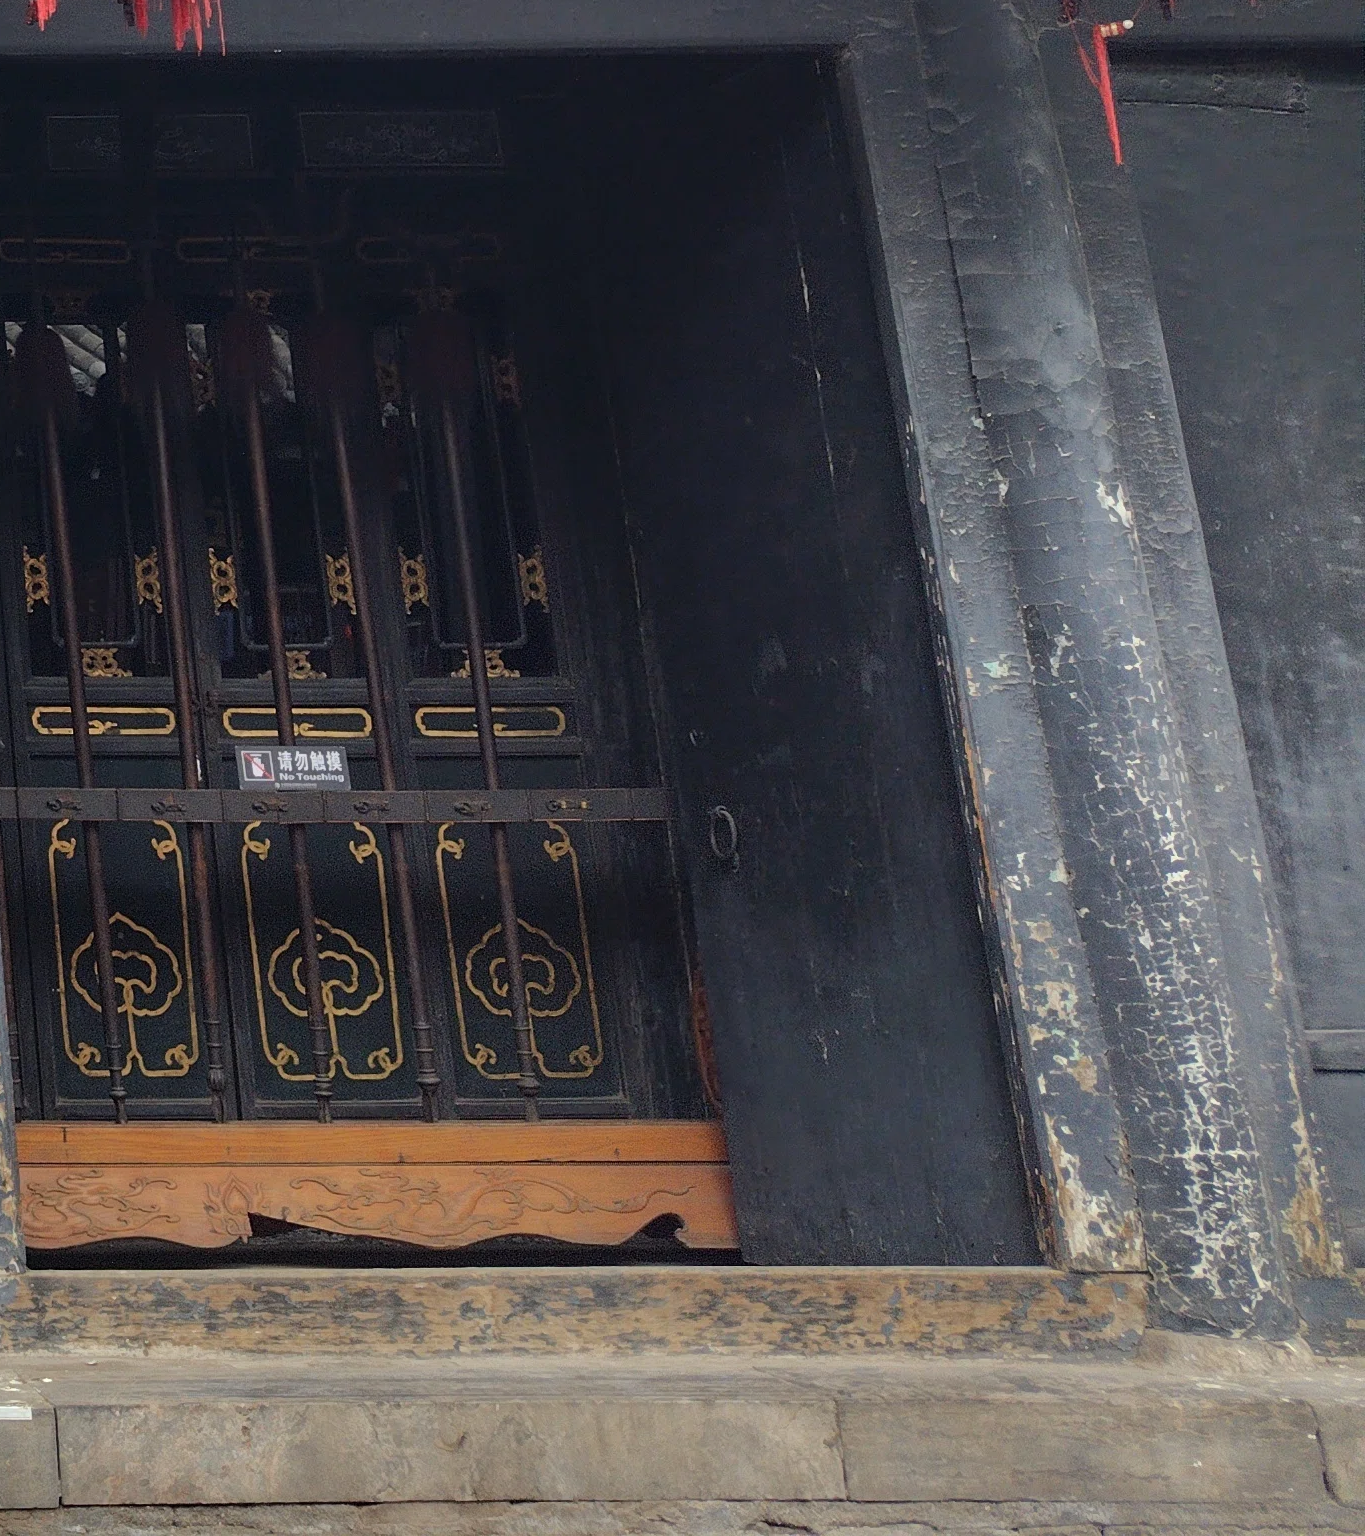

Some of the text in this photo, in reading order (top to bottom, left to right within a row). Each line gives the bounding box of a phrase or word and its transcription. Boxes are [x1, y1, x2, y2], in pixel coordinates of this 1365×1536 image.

[277, 751, 343, 772] 请勿触摸
[279, 772, 345, 782] No Touching
